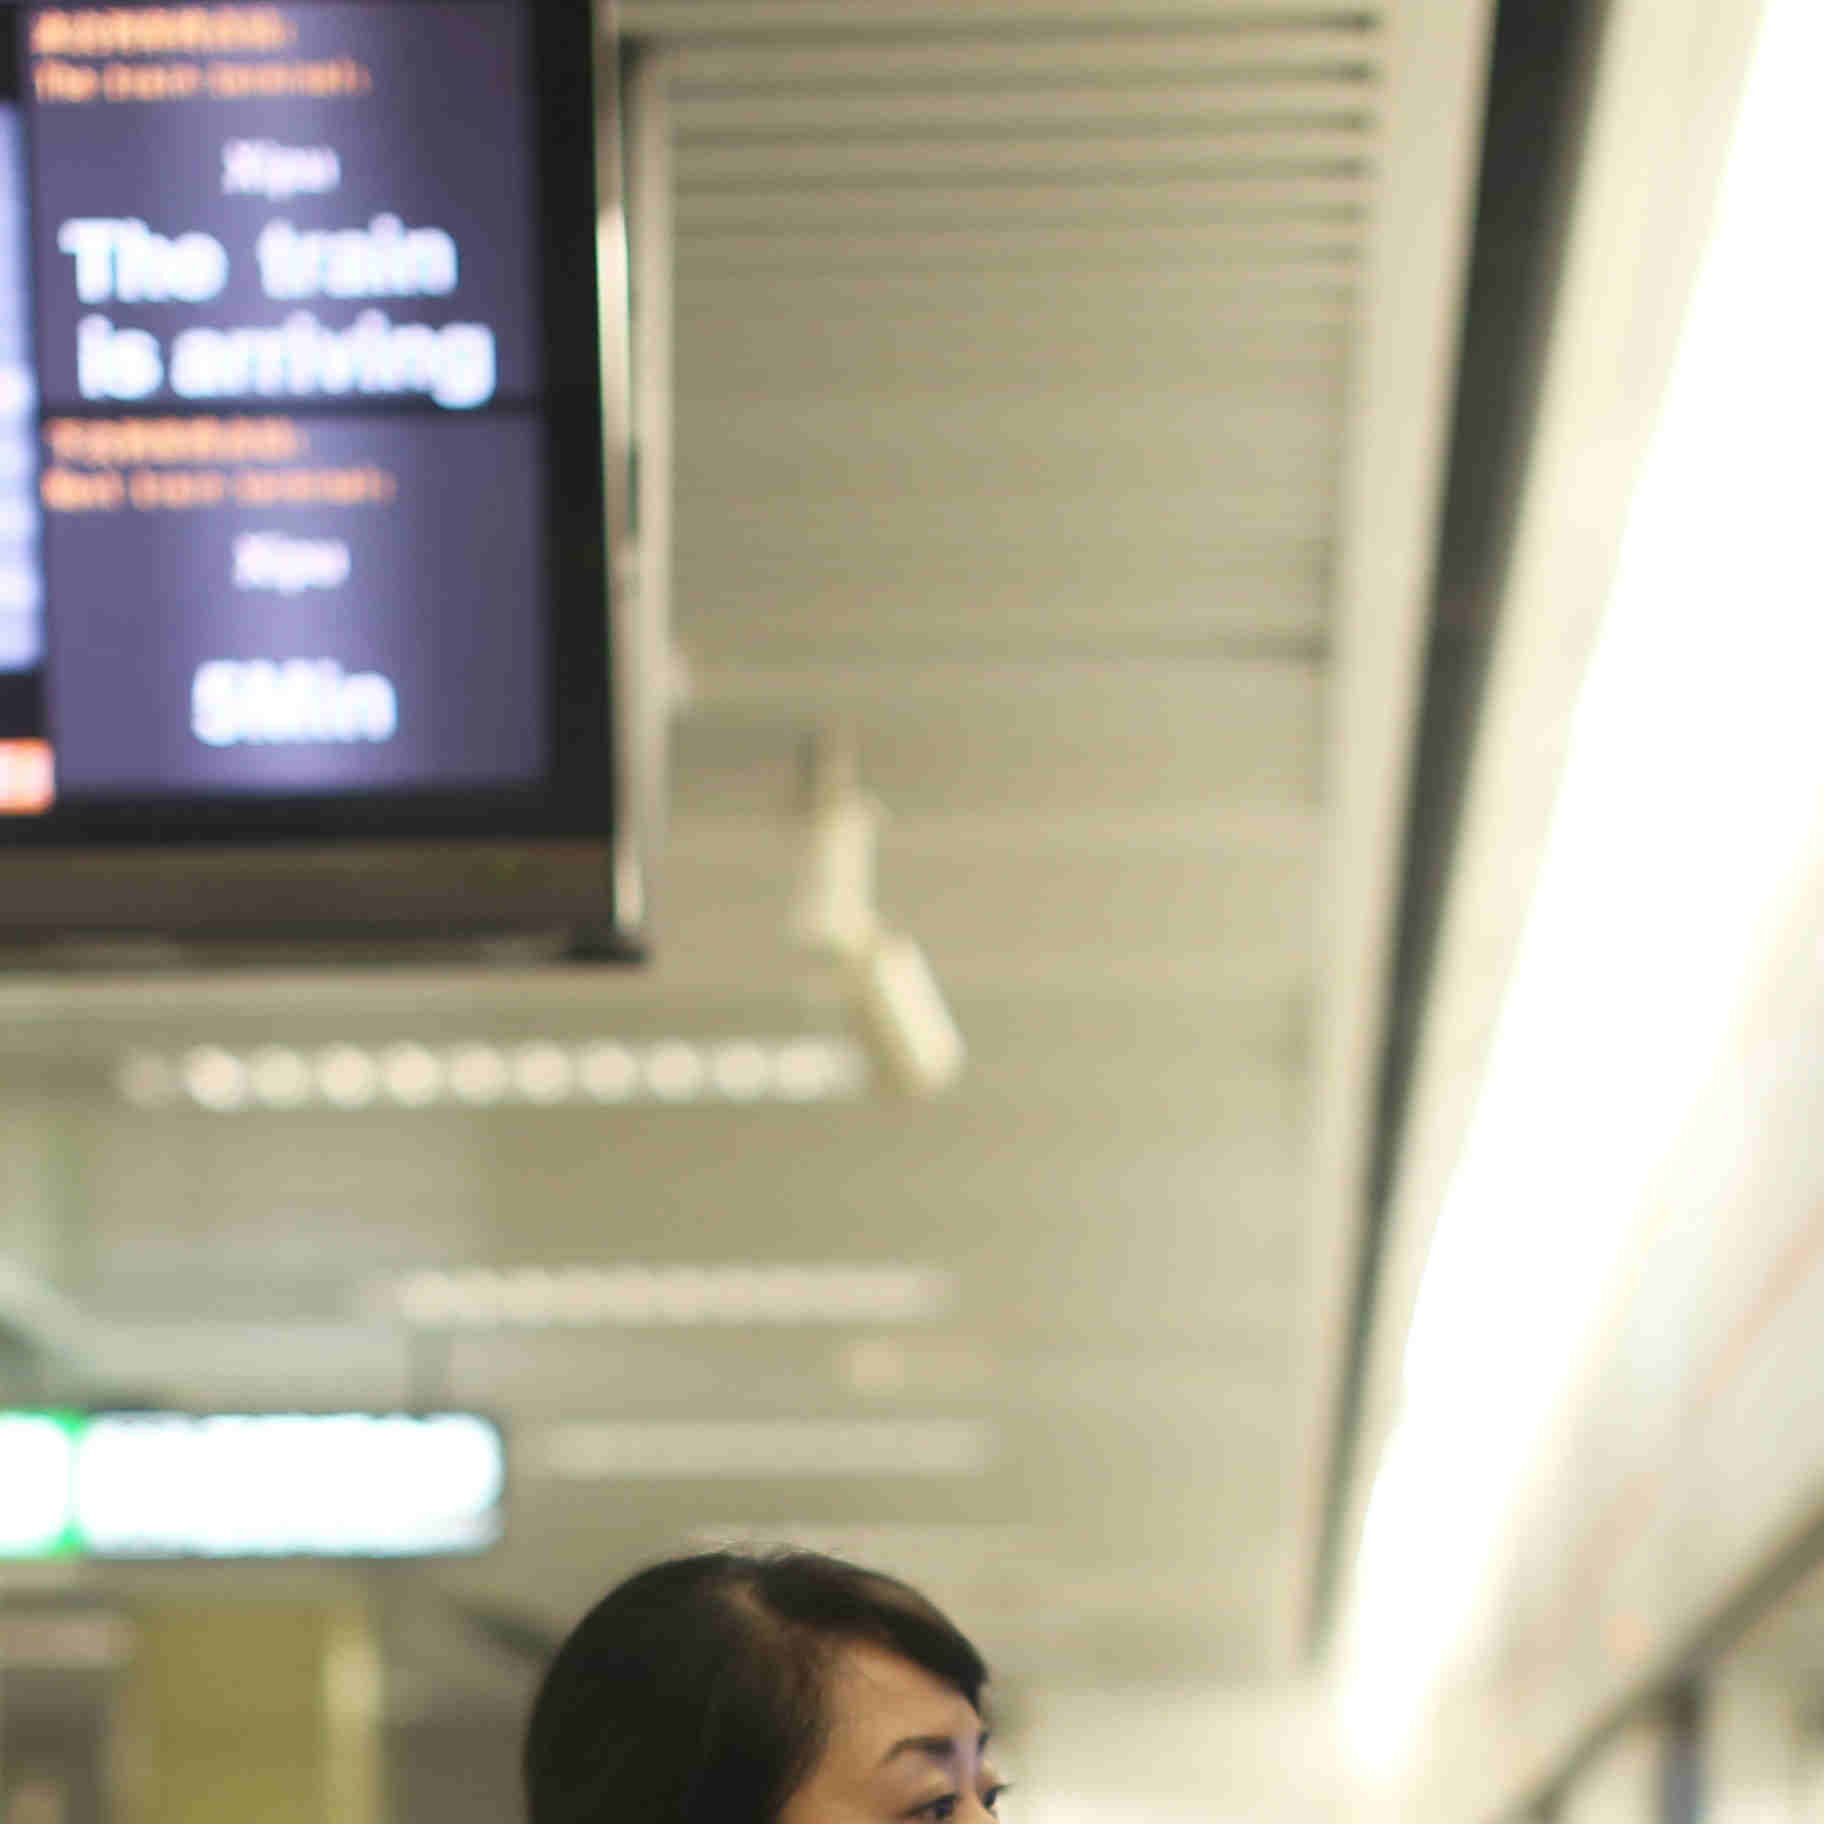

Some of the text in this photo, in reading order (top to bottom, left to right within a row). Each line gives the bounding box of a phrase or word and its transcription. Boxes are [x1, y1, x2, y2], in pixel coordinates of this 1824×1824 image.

[58, 213, 457, 302] The train
[76, 309, 496, 408] is arriving
